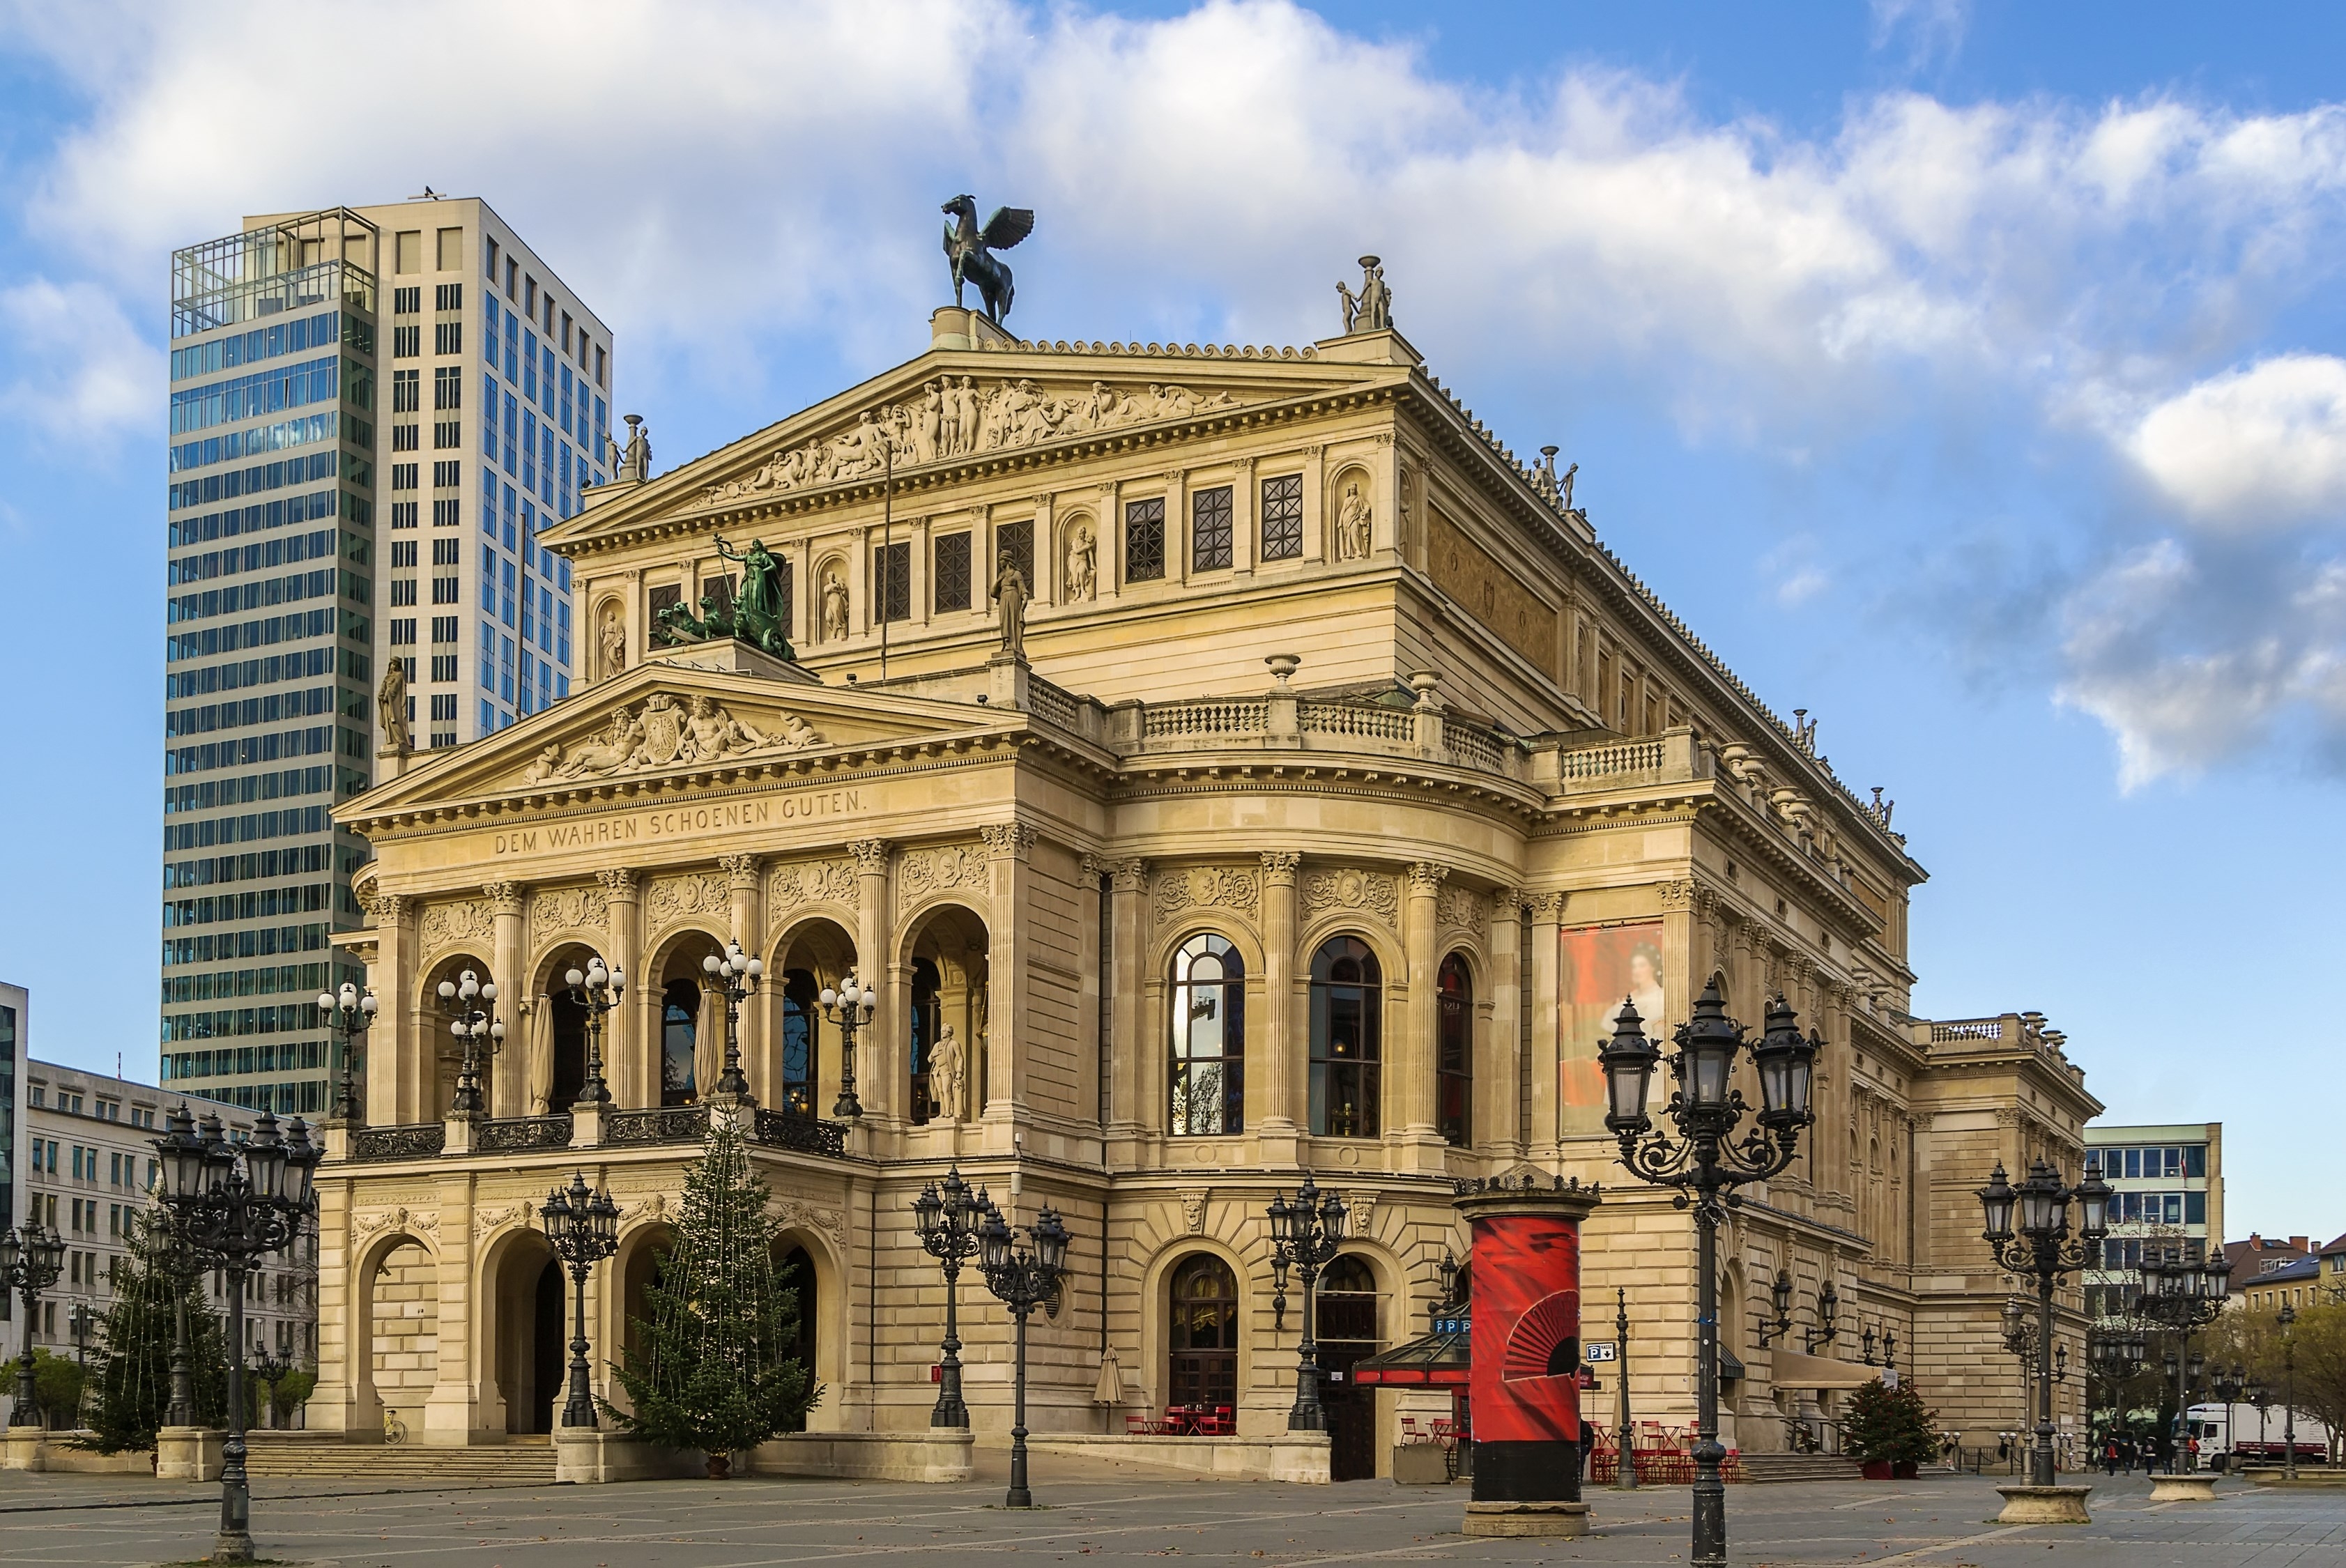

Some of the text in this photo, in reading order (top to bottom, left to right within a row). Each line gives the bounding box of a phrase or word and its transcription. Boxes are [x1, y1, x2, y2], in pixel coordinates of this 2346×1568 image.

[496, 790, 868, 854] DEM WAHREN SCHOENEN GUTEN.
[1437, 1323, 1471, 1333] P P P
[1590, 1349, 1598, 1358] P
